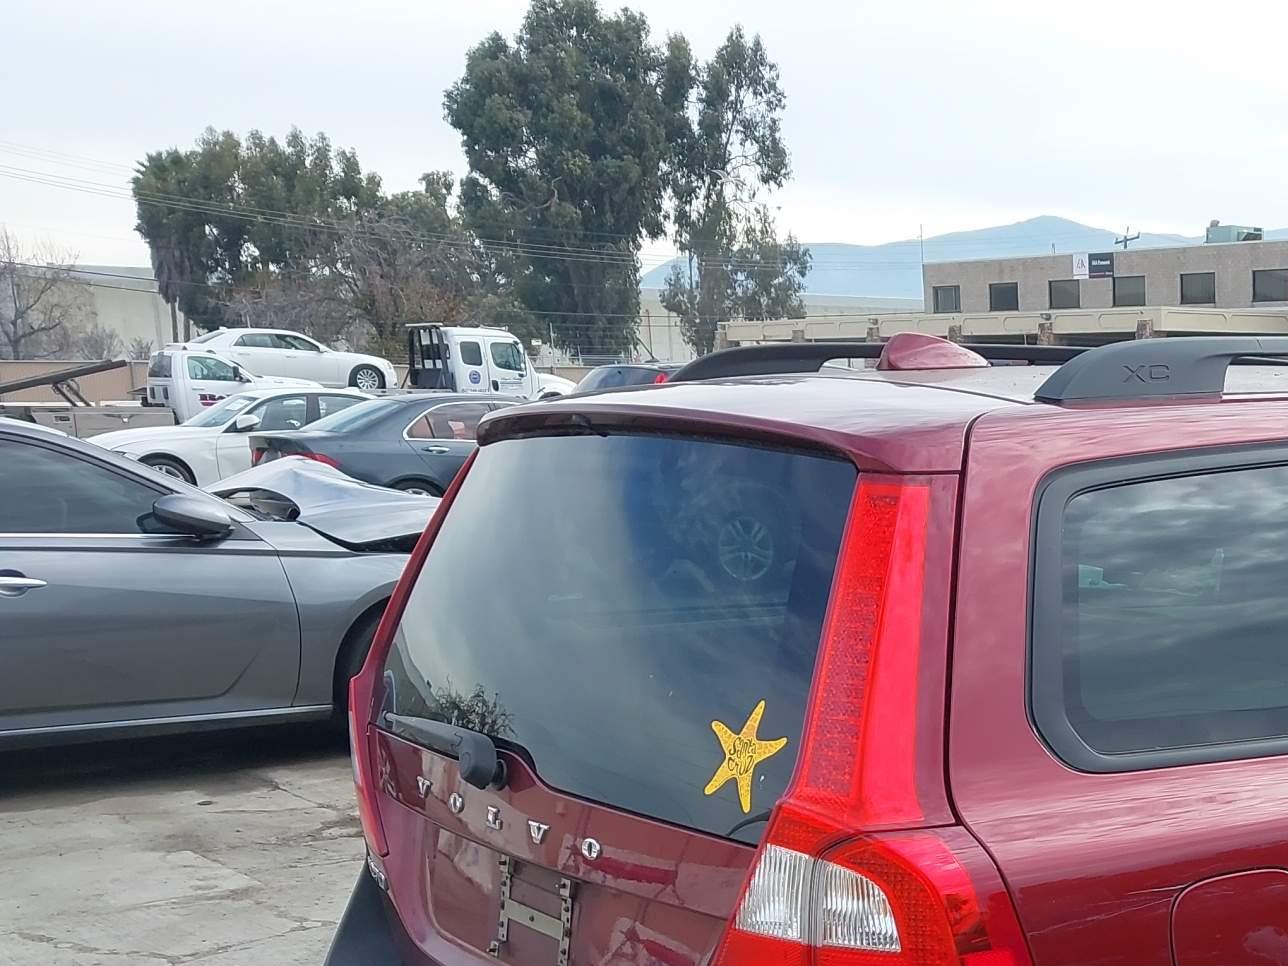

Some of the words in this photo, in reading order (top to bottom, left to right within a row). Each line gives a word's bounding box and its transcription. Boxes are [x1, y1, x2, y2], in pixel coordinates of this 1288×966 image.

[1121, 364, 1171, 384] XC
[728, 736, 757, 759] Santa
[416, 776, 602, 861] VOLVO
